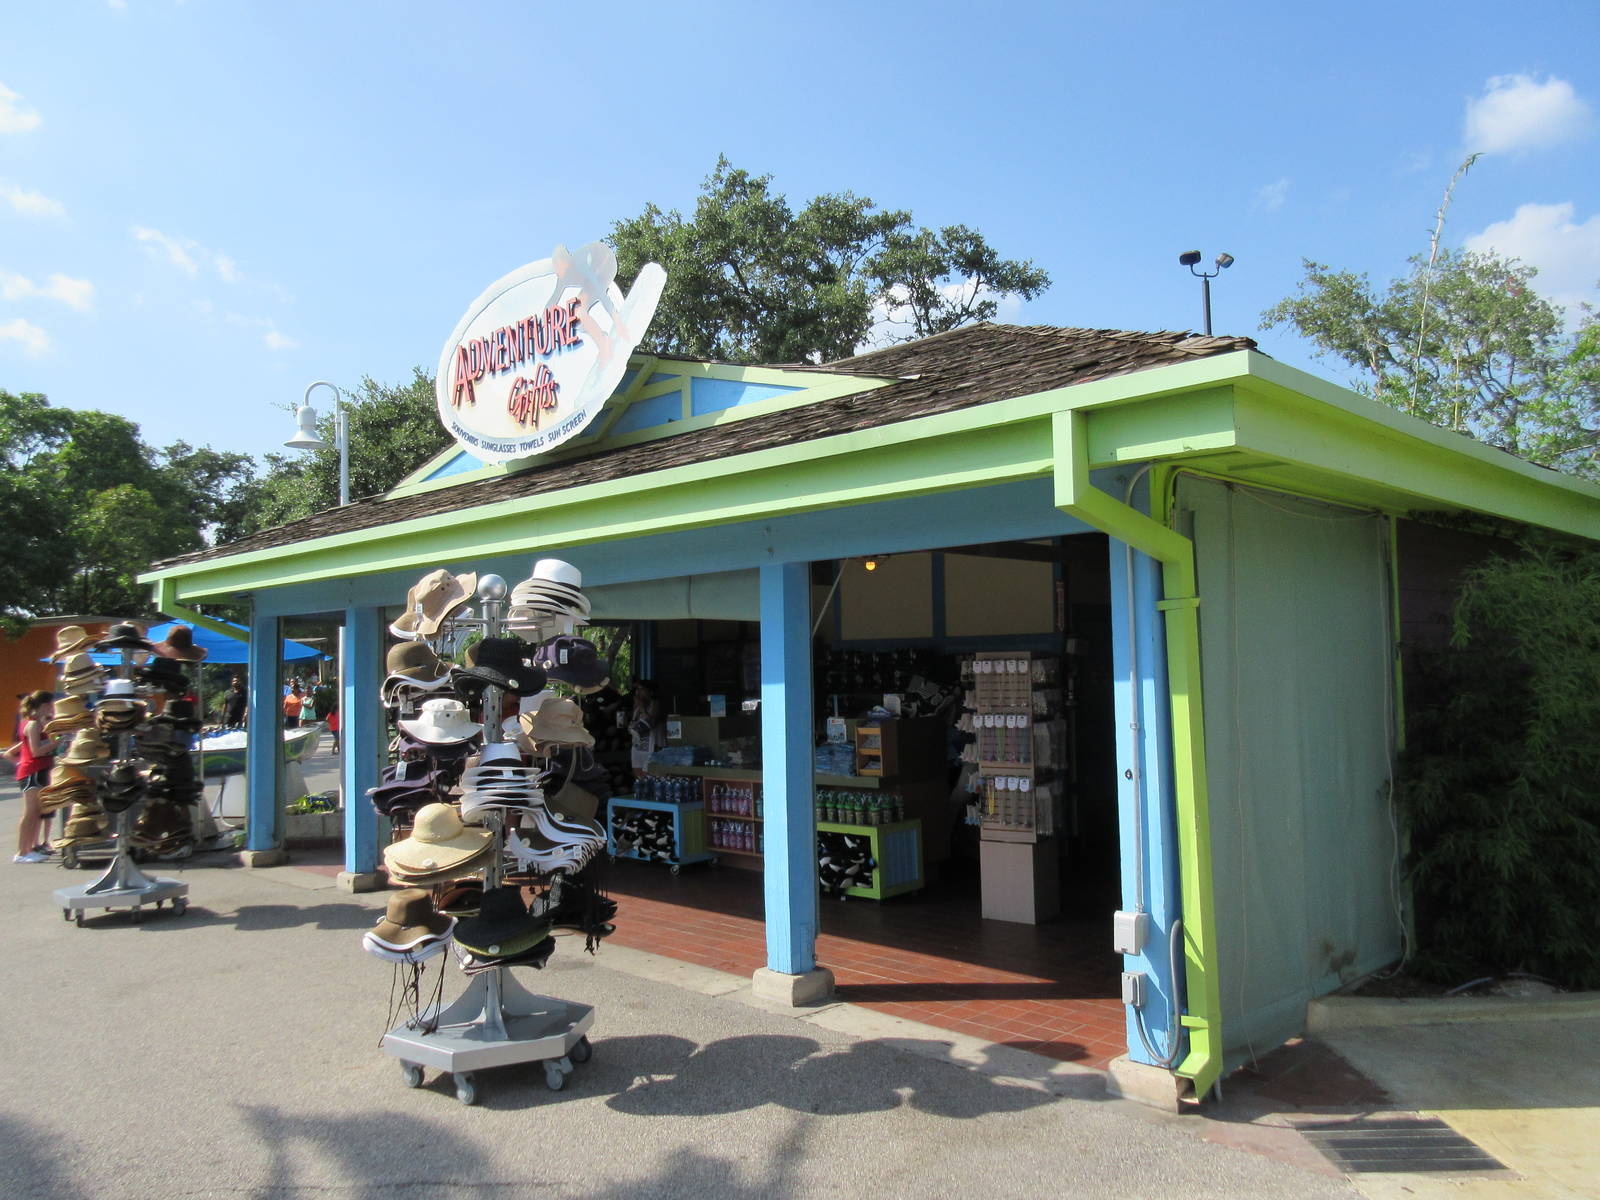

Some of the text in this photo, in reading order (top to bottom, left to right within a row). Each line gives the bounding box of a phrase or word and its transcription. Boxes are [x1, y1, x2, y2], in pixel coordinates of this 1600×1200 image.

[451, 297, 581, 407] ADVENTURE
[508, 362, 556, 426] Gifts
[481, 440, 516, 453] SUNGLASSES
[520, 437, 544, 452] TOWELS
[548, 429, 561, 442] SUN
[562, 410, 587, 436] SCREEN
